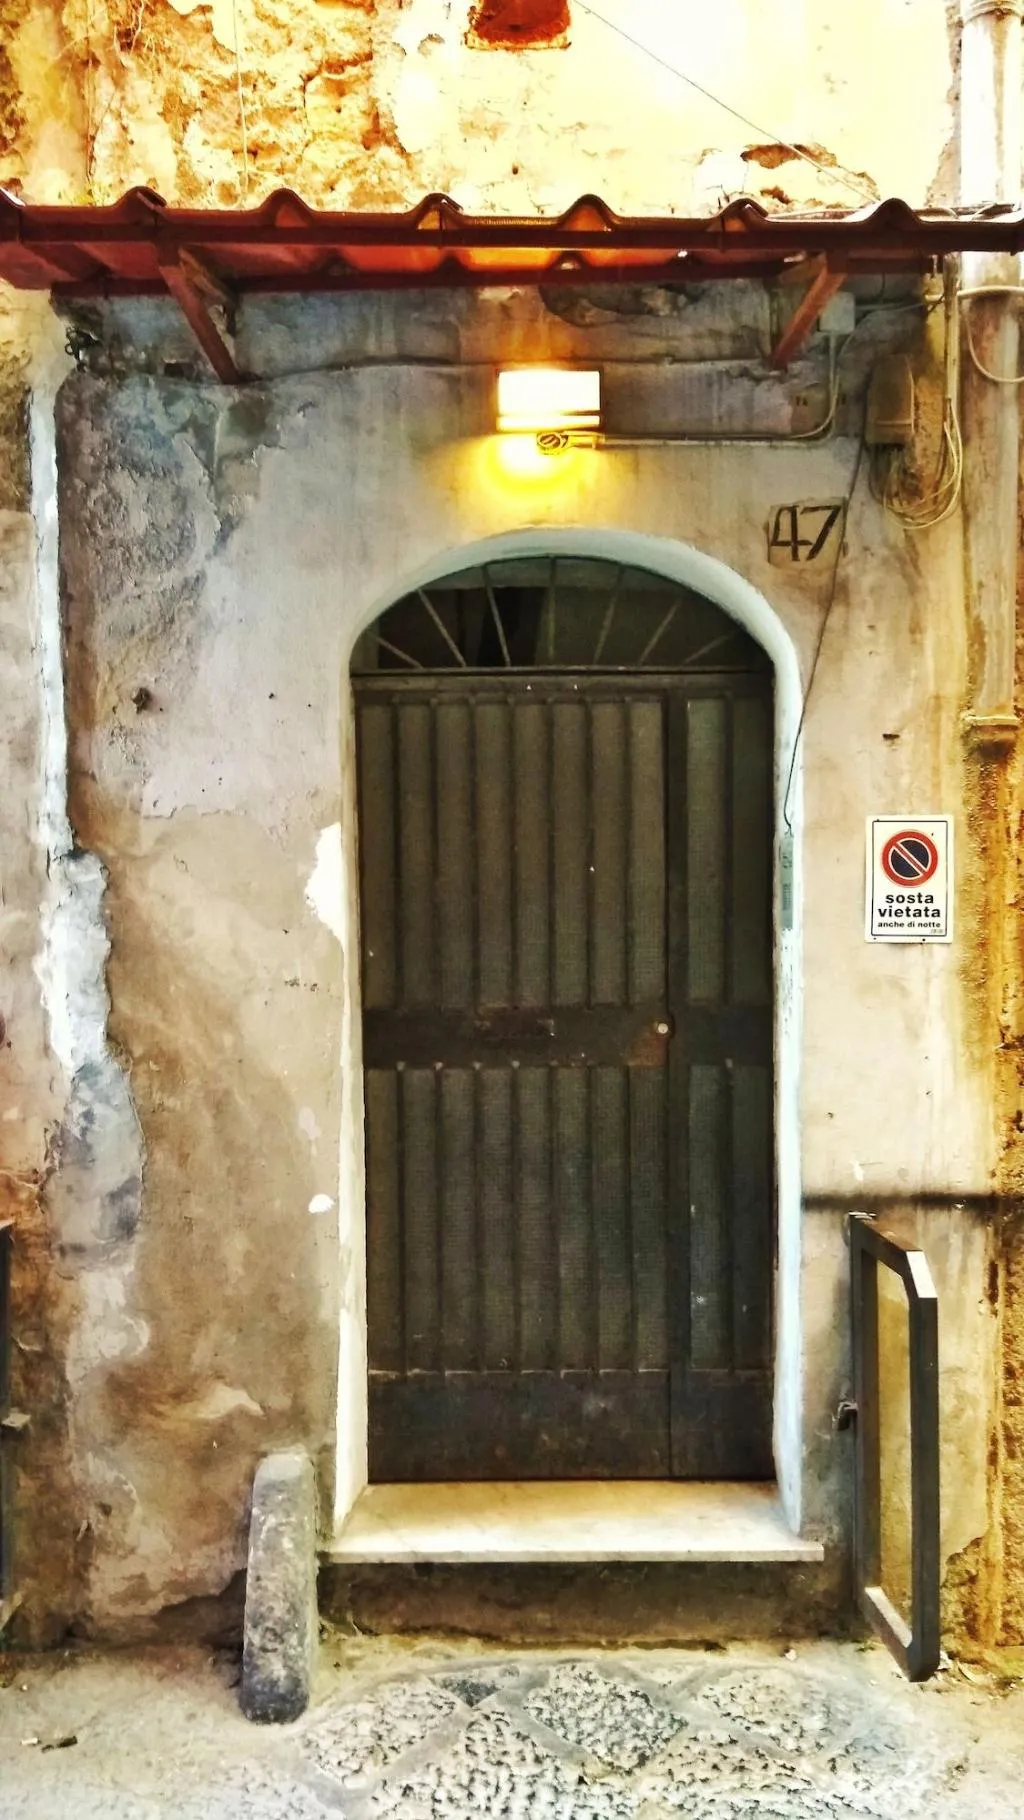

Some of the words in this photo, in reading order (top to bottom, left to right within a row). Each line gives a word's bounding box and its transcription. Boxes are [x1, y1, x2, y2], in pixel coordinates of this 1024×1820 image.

[770, 505, 841, 562] 47
[885, 892, 934, 904] sosta
[877, 905, 941, 918] vietata
